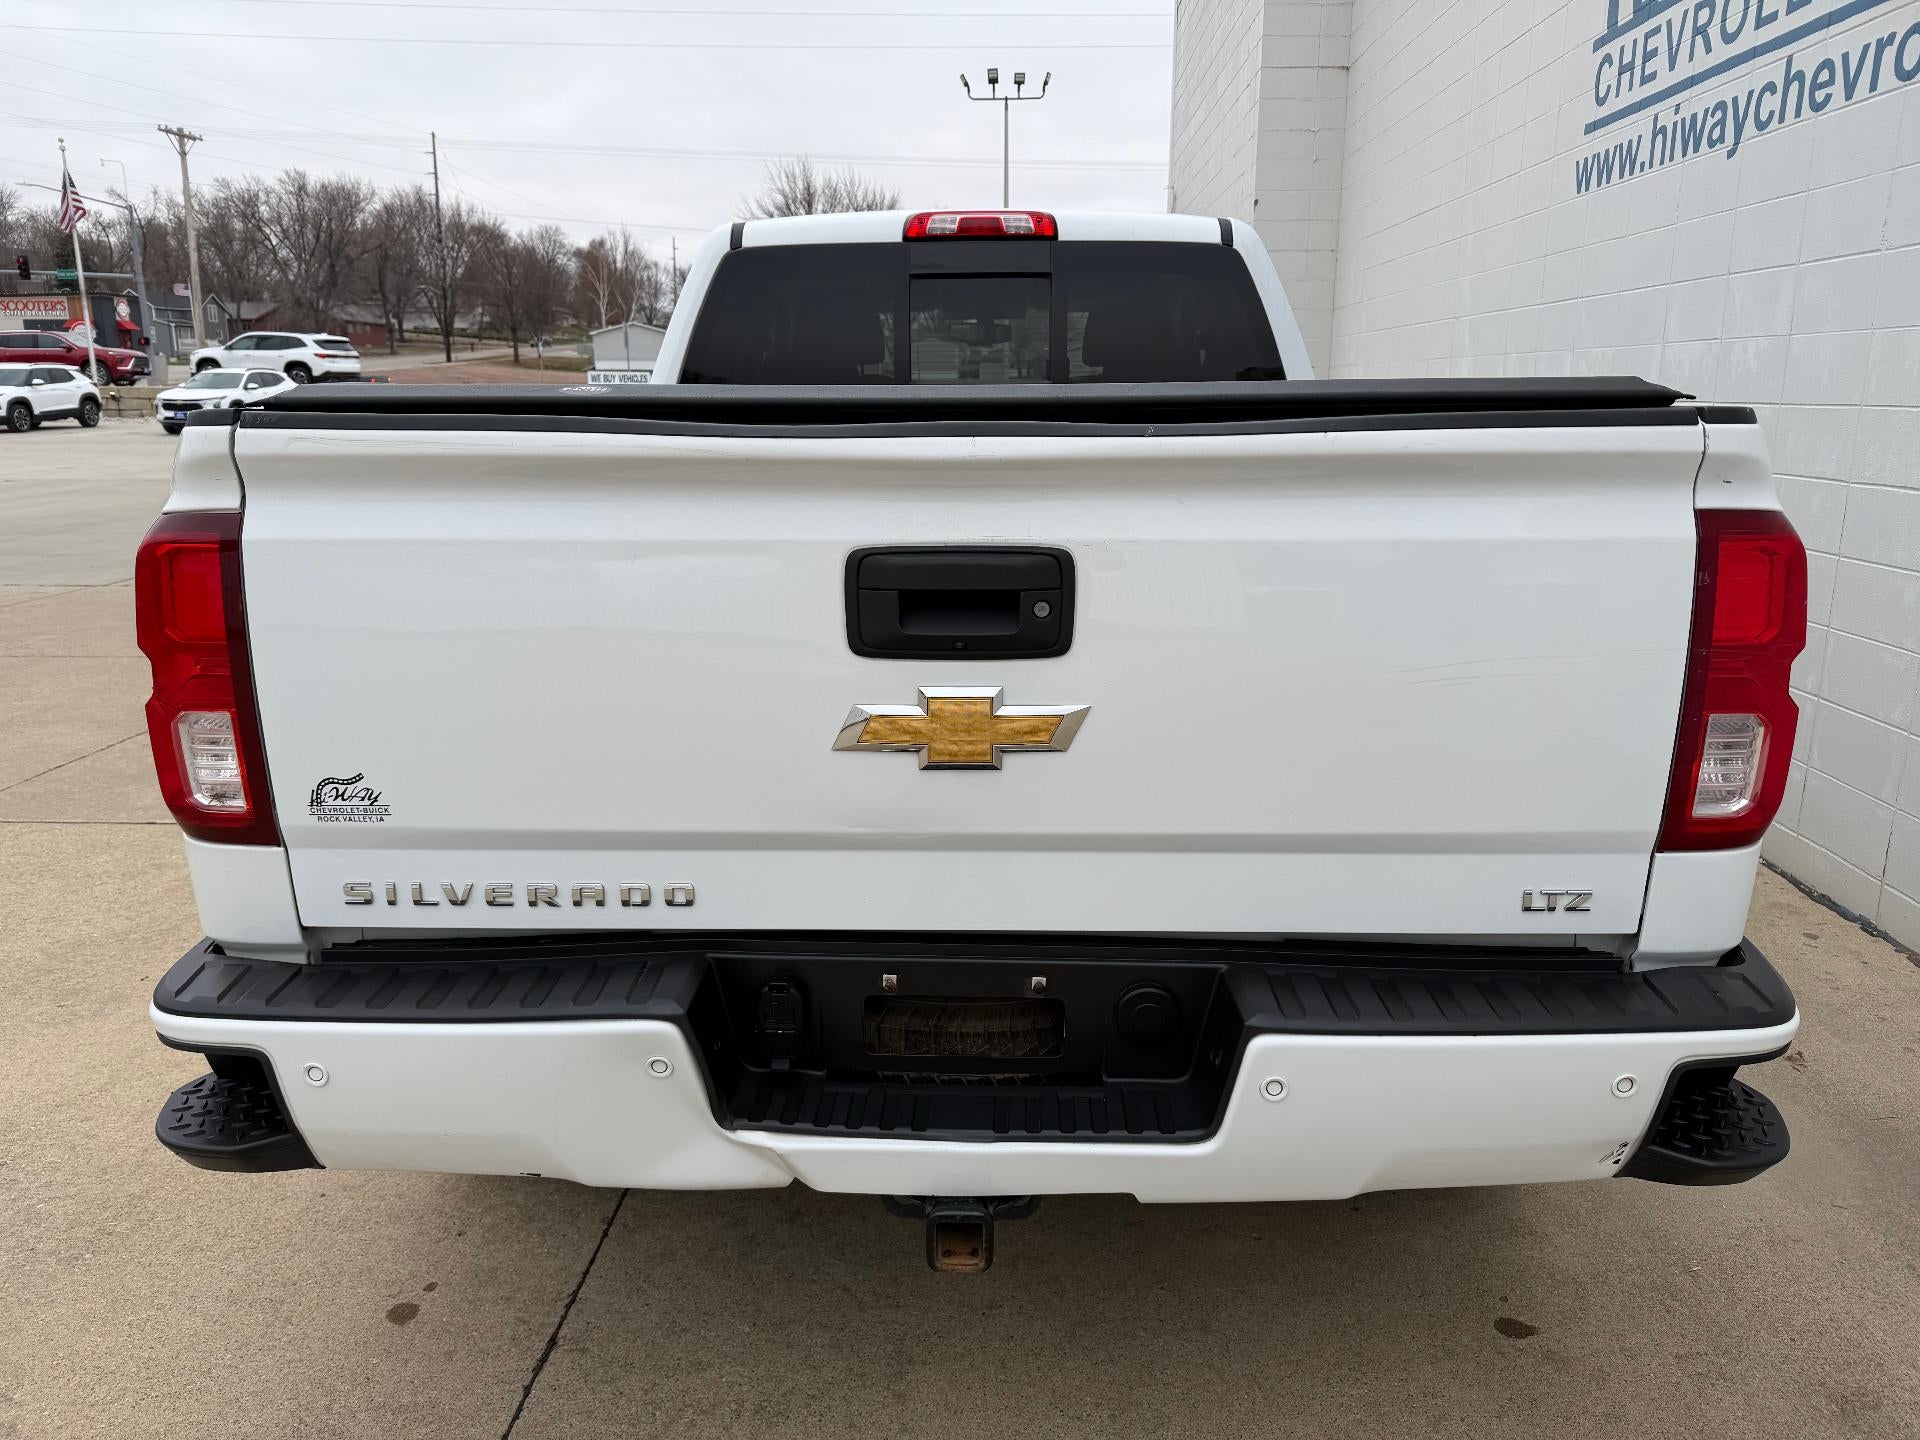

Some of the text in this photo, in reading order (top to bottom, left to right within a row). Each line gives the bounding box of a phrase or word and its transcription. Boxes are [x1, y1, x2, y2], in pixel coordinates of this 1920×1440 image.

[0, 300, 66, 311] SCOOTER'S
[591, 374, 648, 383] WE BUY VEHICLES
[317, 815, 342, 823] ROCK
[343, 815, 375, 823] VALLEY,
[342, 881, 696, 907] SILVERADO
[1521, 889, 1593, 912] LTZ
